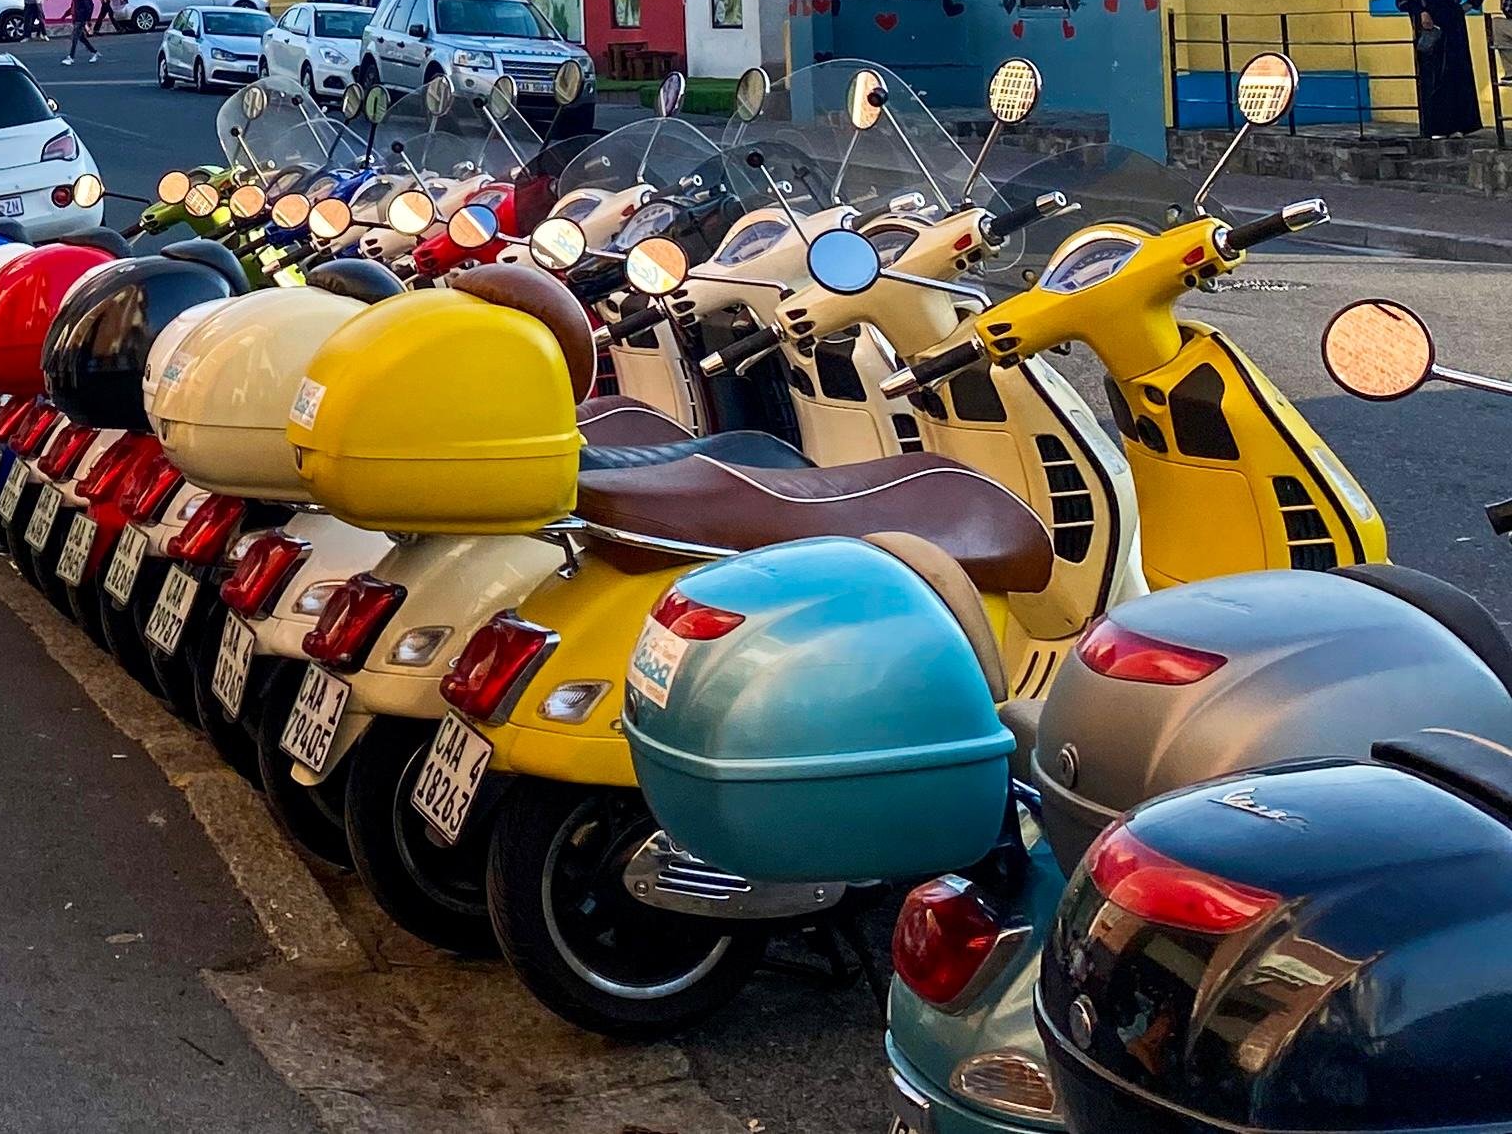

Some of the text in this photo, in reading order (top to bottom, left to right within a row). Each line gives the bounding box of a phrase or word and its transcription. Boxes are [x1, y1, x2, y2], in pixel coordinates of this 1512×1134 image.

[6, 200, 20, 213] ZN
[135, 538, 146, 563] 4
[166, 573, 189, 610] CAA
[148, 603, 183, 646] 29937
[222, 616, 252, 668] CAA 4
[214, 654, 243, 708] 18260
[299, 668, 345, 727] CAA 1
[284, 708, 332, 766] 79405
[436, 717, 488, 788] CAA 4
[416, 761, 470, 832] 18263
